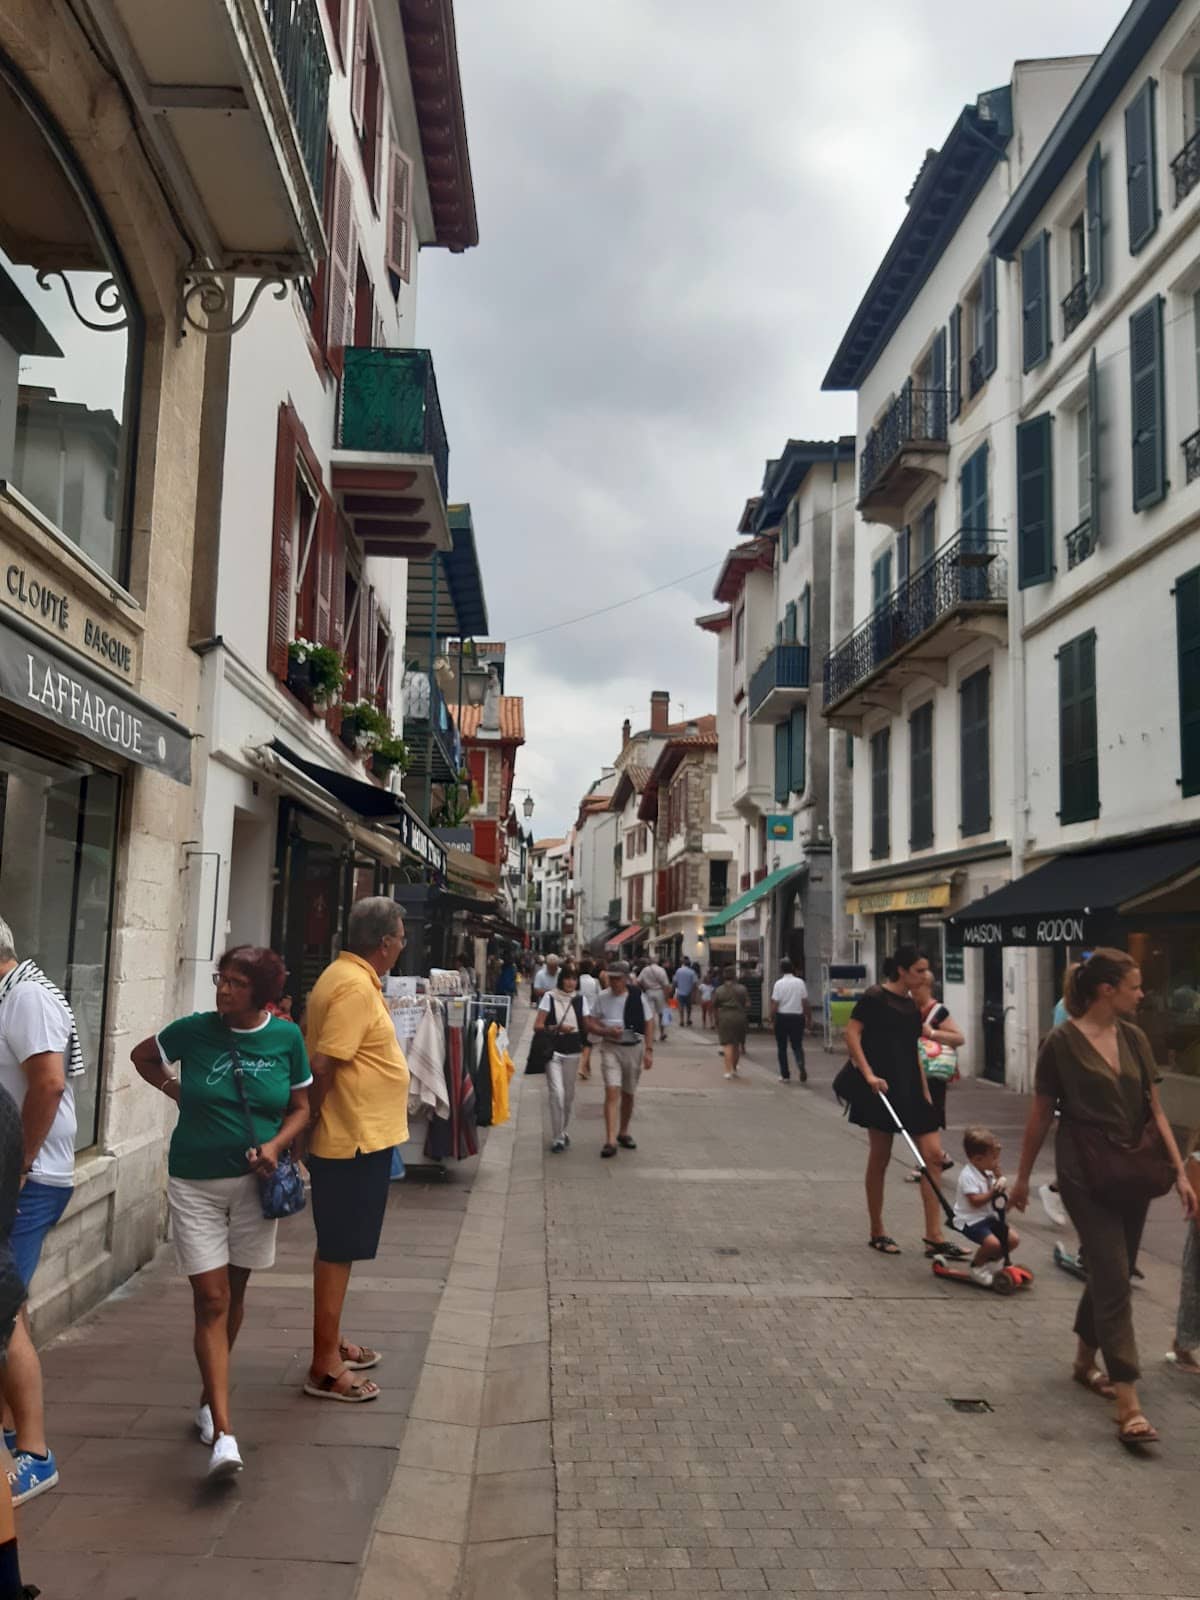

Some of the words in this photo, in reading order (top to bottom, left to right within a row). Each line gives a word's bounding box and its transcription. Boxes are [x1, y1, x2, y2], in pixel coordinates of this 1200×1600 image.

[7, 565, 69, 630] CLOUTÉ
[84, 618, 131, 672] BASQUE
[27, 655, 143, 753] LAFFARGUE
[964, 923, 1002, 943] MAISON
[1037, 918, 1083, 942] RODON
